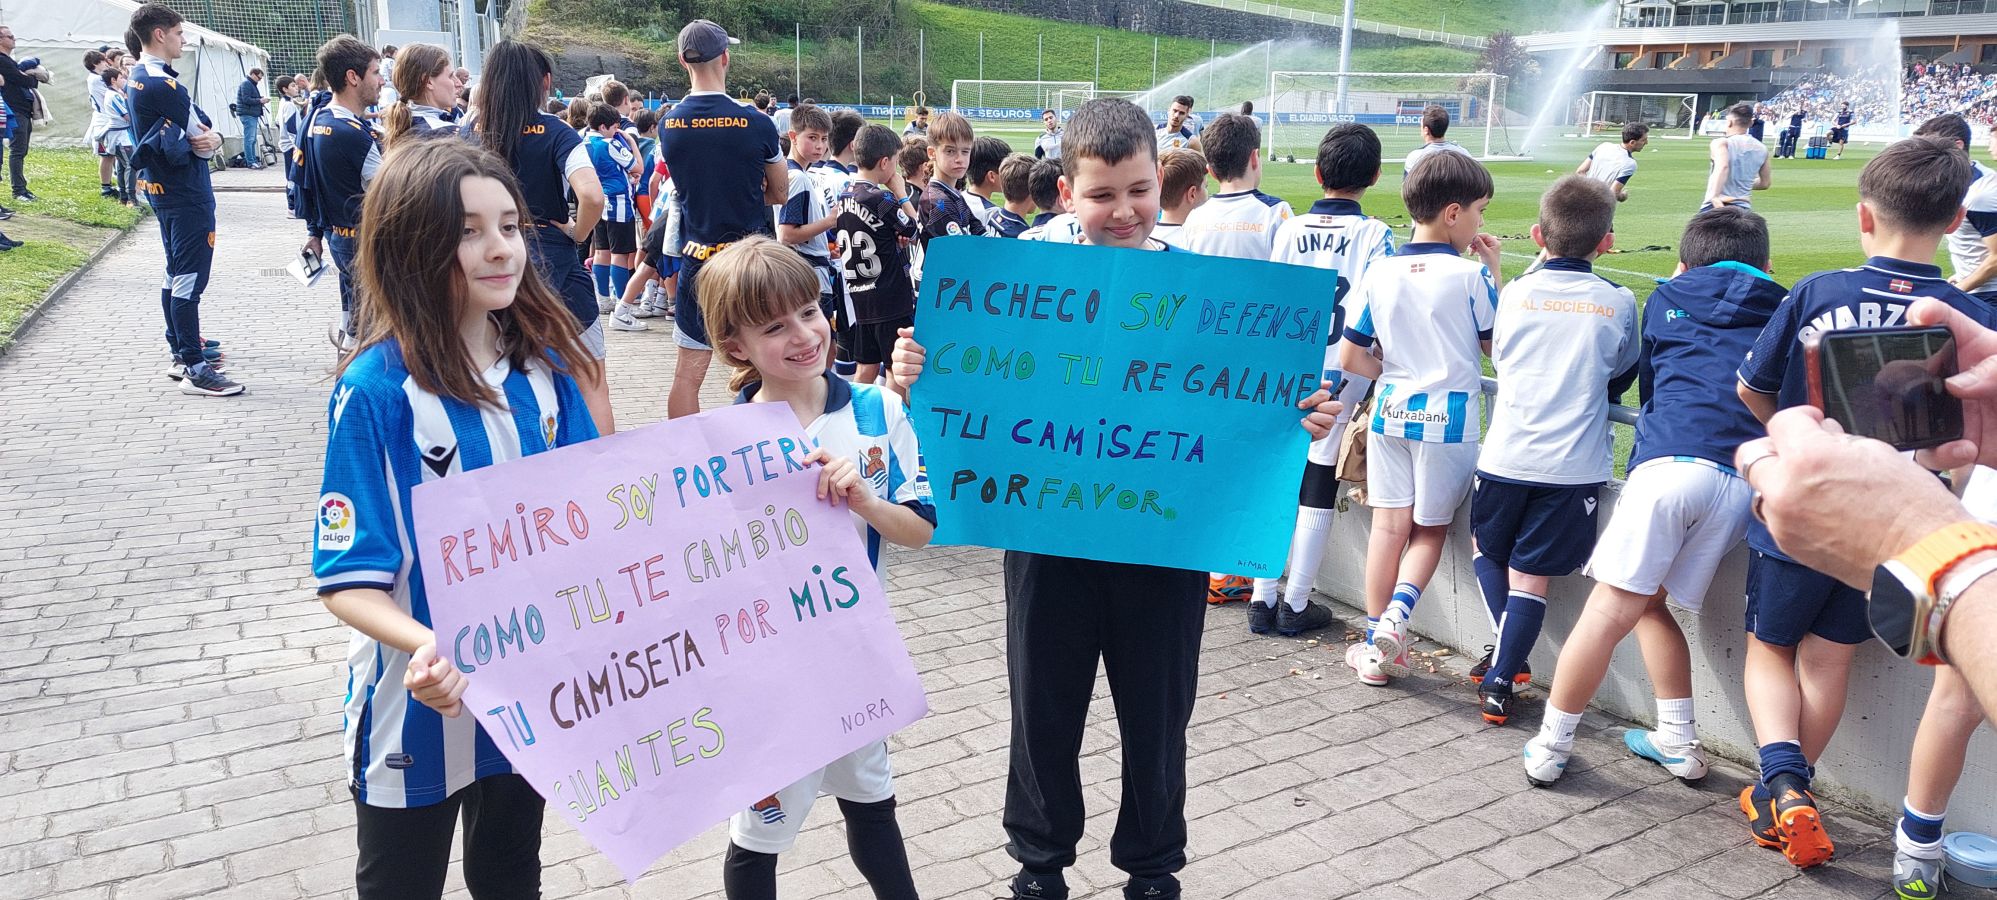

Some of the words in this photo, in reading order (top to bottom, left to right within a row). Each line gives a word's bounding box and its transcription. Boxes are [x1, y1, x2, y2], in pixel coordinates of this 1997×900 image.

[665, 118, 688, 129] REAL
[691, 117, 749, 129] SOCIEDAD
[978, 109, 1032, 118] SEGUROS
[1300, 114, 1328, 122] DIARIO
[844, 197, 885, 232] MÉNDEZ
[836, 229, 882, 279] 23
[1297, 232, 1351, 256] UNAX
[935, 277, 1101, 324] PACHECO
[1120, 292, 1187, 331] SOY
[1196, 298, 1321, 344] DEFENSA
[1542, 300, 1615, 318] SOCIEDAD
[932, 342, 1036, 381] COMO
[1058, 352, 1103, 386] TU
[931, 407, 989, 441] TU
[1011, 418, 1204, 463] CAMiSETA
[440, 500, 589, 585] REMiRO
[606, 473, 658, 530] SOY
[454, 604, 545, 673] COMO
[617, 554, 669, 607] TE
[684, 504, 809, 583] CAMBiO
[487, 701, 536, 752] TU
[549, 629, 705, 729] CAMiSETA
[715, 599, 778, 654] POR
[840, 698, 895, 734] NORA
